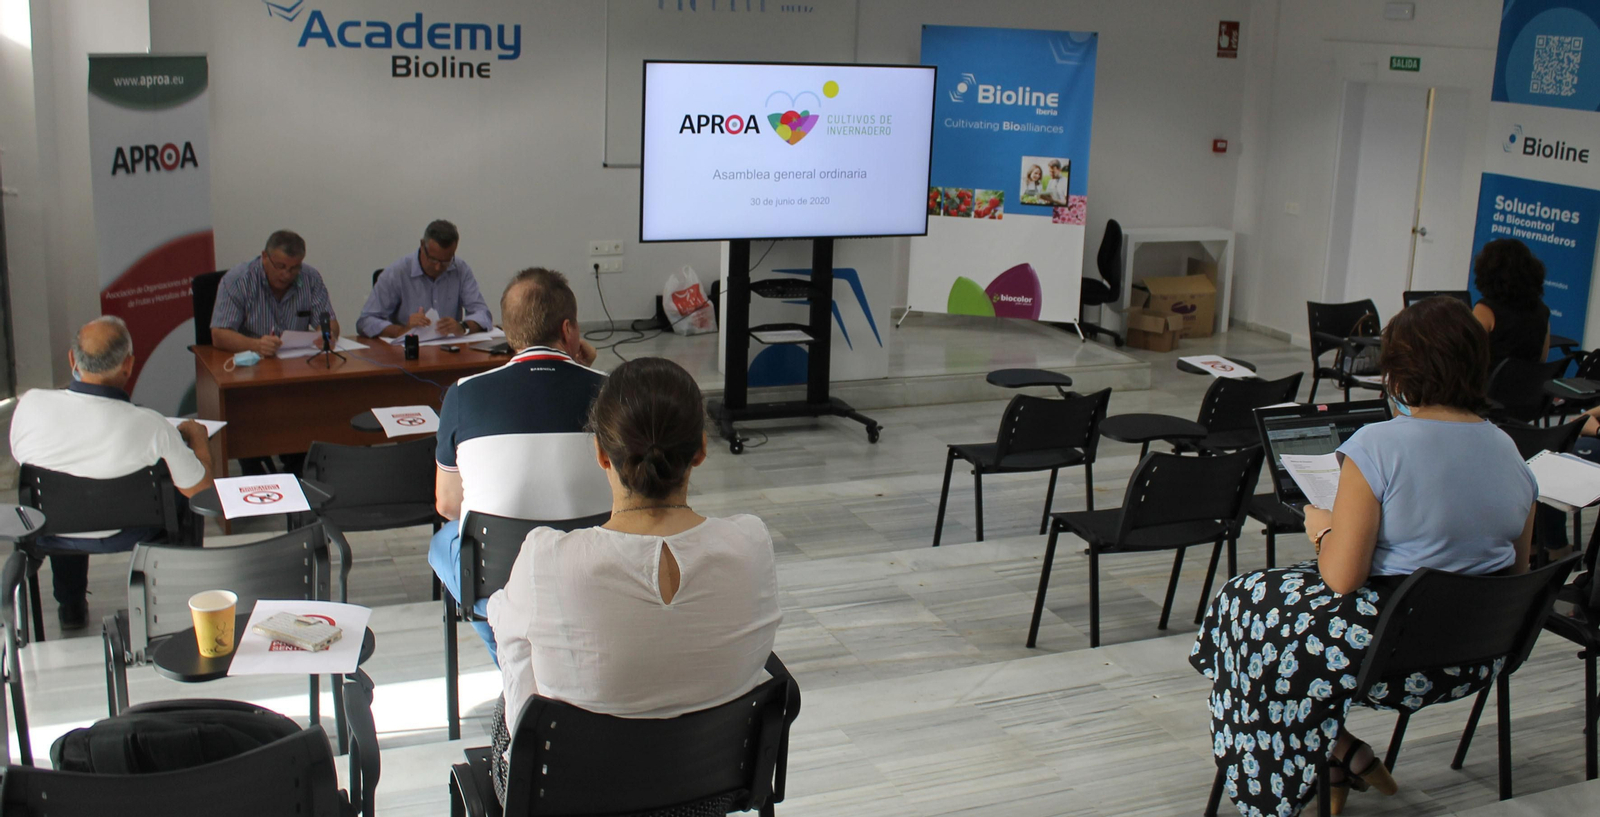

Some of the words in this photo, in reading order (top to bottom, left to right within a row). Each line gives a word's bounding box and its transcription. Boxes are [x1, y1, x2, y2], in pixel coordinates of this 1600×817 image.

[297, 10, 522, 60] Academy
[391, 55, 491, 79] Bioline
[1392, 57, 1418, 69] SALIDA
[113, 75, 184, 88] www.aproa.eu
[977, 84, 1060, 108] Bioline
[827, 114, 876, 125] CULTIVOS
[879, 115, 892, 124] DE
[1036, 108, 1058, 116] Iberia
[679, 114, 761, 135] APROA
[826, 126, 892, 136] INVERNADERO
[944, 118, 1000, 131] Cultivating
[1002, 121, 1064, 134] Bioalliances
[111, 141, 199, 176] APROA
[1522, 137, 1590, 163] Bioline
[712, 168, 771, 180] Asamblea
[773, 168, 816, 182] general
[819, 168, 868, 180] ordinaria
[750, 197, 761, 206] 30
[763, 197, 774, 206] de
[775, 197, 796, 208] junio
[797, 197, 808, 206] de
[809, 196, 830, 206] 2020
[1494, 195, 1581, 224] Soluciones
[1492, 212, 1505, 222] de
[1506, 214, 1556, 232] Biocontrol
[1491, 223, 1512, 235] para
[1512, 228, 1577, 248] invernaderos
[1001, 294, 1033, 303] biocolor
